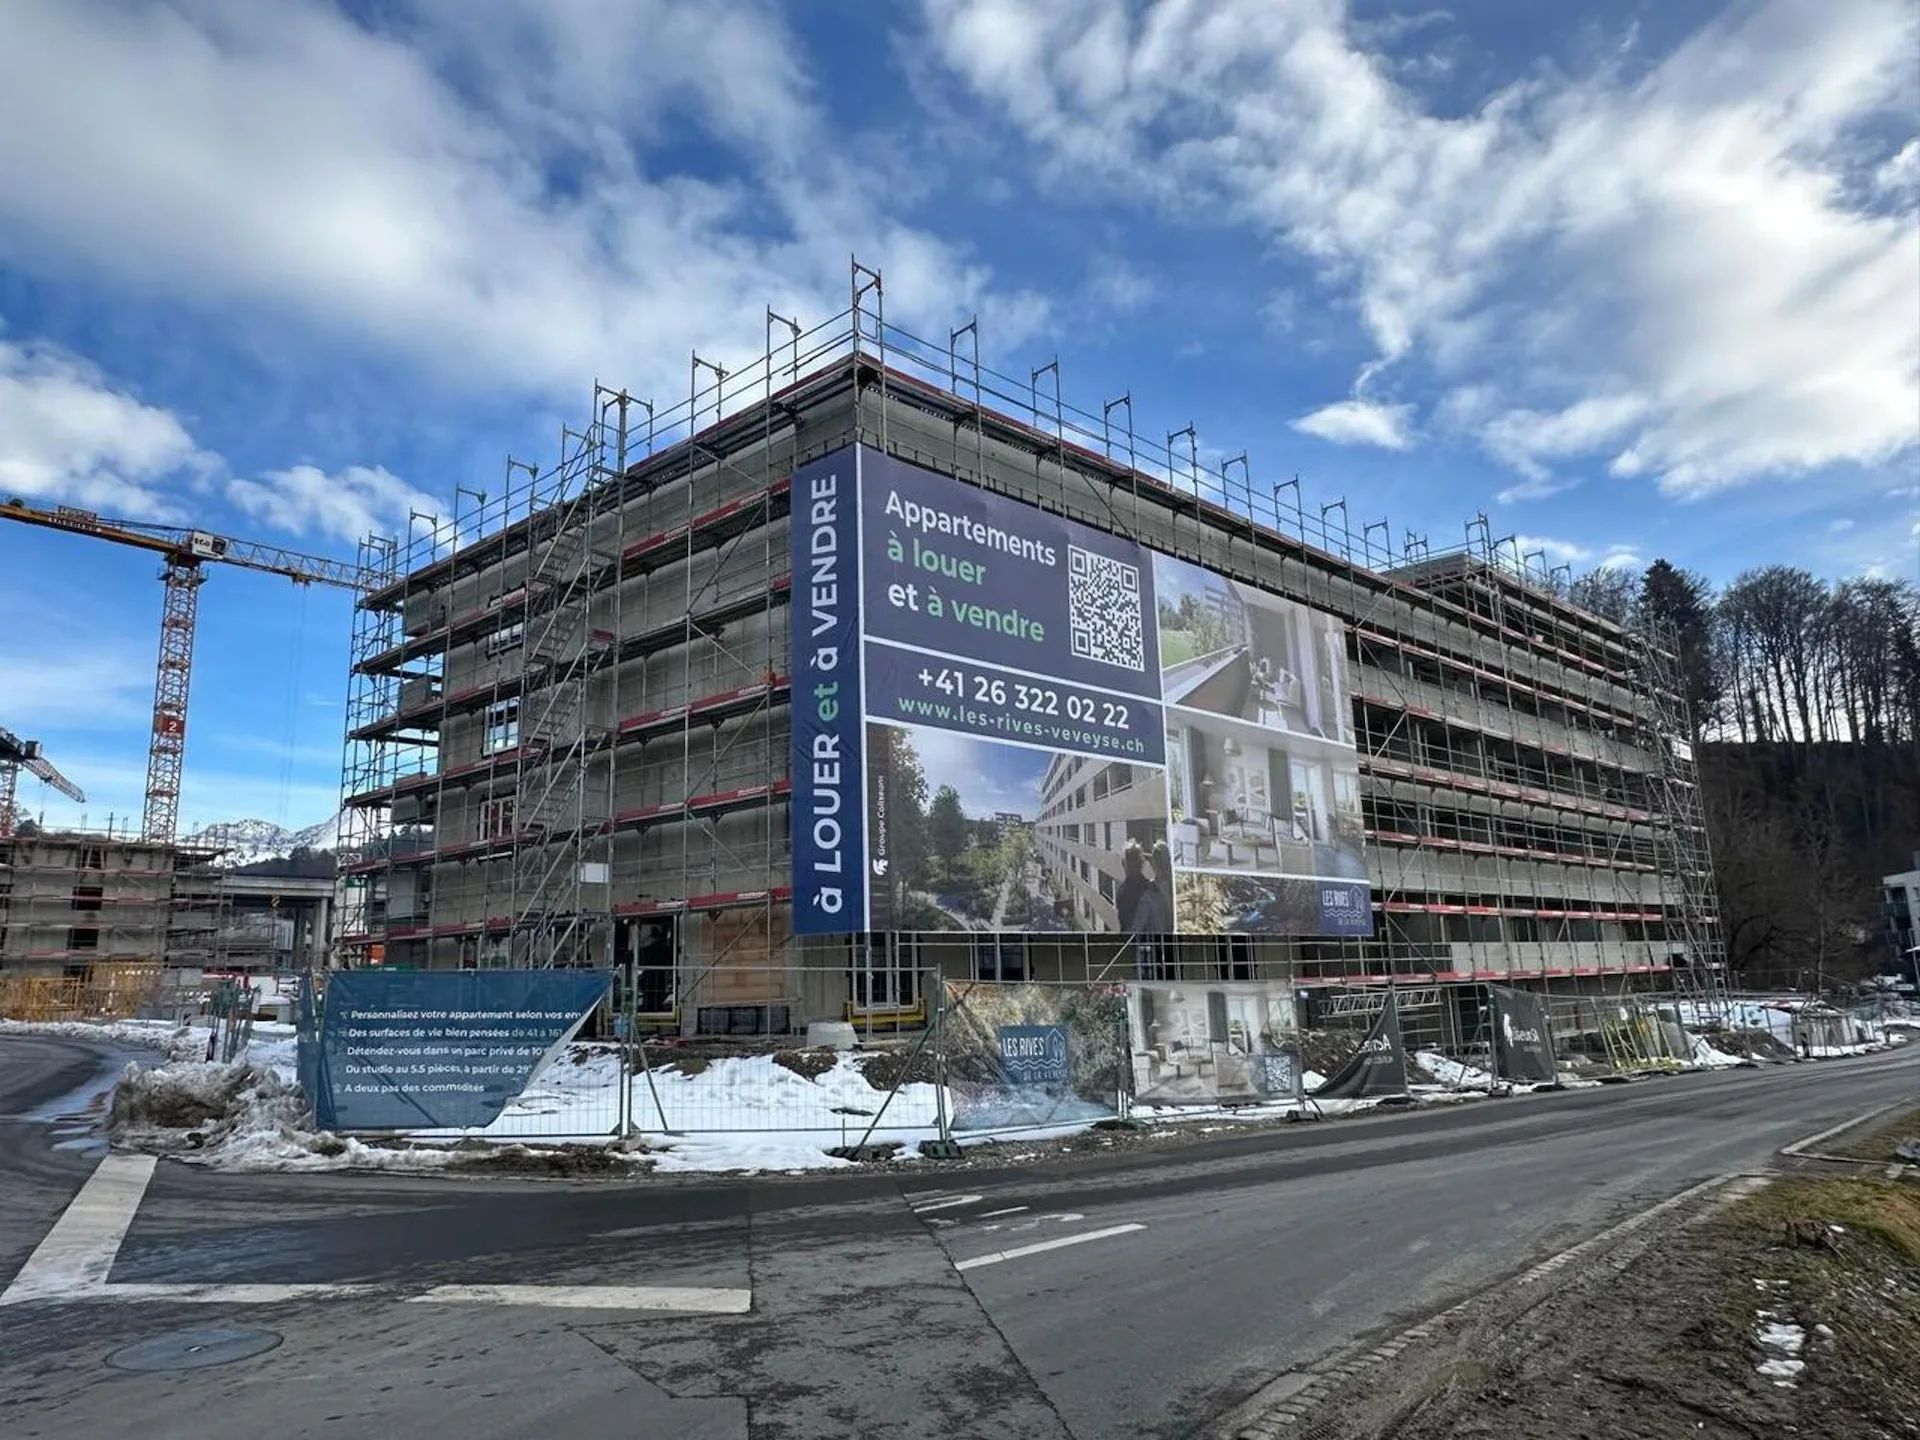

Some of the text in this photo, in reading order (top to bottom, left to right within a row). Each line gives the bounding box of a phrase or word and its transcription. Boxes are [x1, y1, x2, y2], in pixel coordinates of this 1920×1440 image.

[884, 490, 1056, 566] Appartements
[887, 530, 986, 585] à louer
[888, 583, 1045, 642] et à vendre
[810, 474, 843, 914] à LOUER et à VENDRE
[918, 668, 1130, 730] +41 26 322 02 22
[169, 720, 177, 732] 2
[898, 697, 1145, 754] www.les-rives-veveyse.ch
[877, 820, 886, 856] Groupe
[351, 1010, 418, 1020] Personnalisez
[420, 1010, 447, 1019] votre
[449, 1010, 513, 1021] appartement
[515, 1009, 543, 1020] selon
[545, 1011, 563, 1020] vos
[348, 1028, 368, 1038] Des
[369, 1027, 411, 1038] surfaces
[412, 1028, 426, 1037] de
[428, 1027, 443, 1038] vie
[445, 1027, 468, 1038] bien
[469, 1028, 510, 1039] pensées
[1003, 1037, 1018, 1056] LES
[347, 1046, 421, 1056] Détendez-vous
[423, 1046, 450, 1056] dans
[464, 1046, 487, 1057] parc
[489, 1046, 514, 1057] privé
[516, 1046, 530, 1056] de
[345, 1064, 361, 1074] Du
[362, 1064, 394, 1074] studio
[395, 1066, 409, 1074] au
[410, 1064, 427, 1074] 5.5
[472, 1065, 500, 1075] partir
[501, 1064, 516, 1074] de
[354, 1083, 379, 1093] deux
[381, 1085, 400, 1094] pas
[401, 1083, 420, 1092] des
